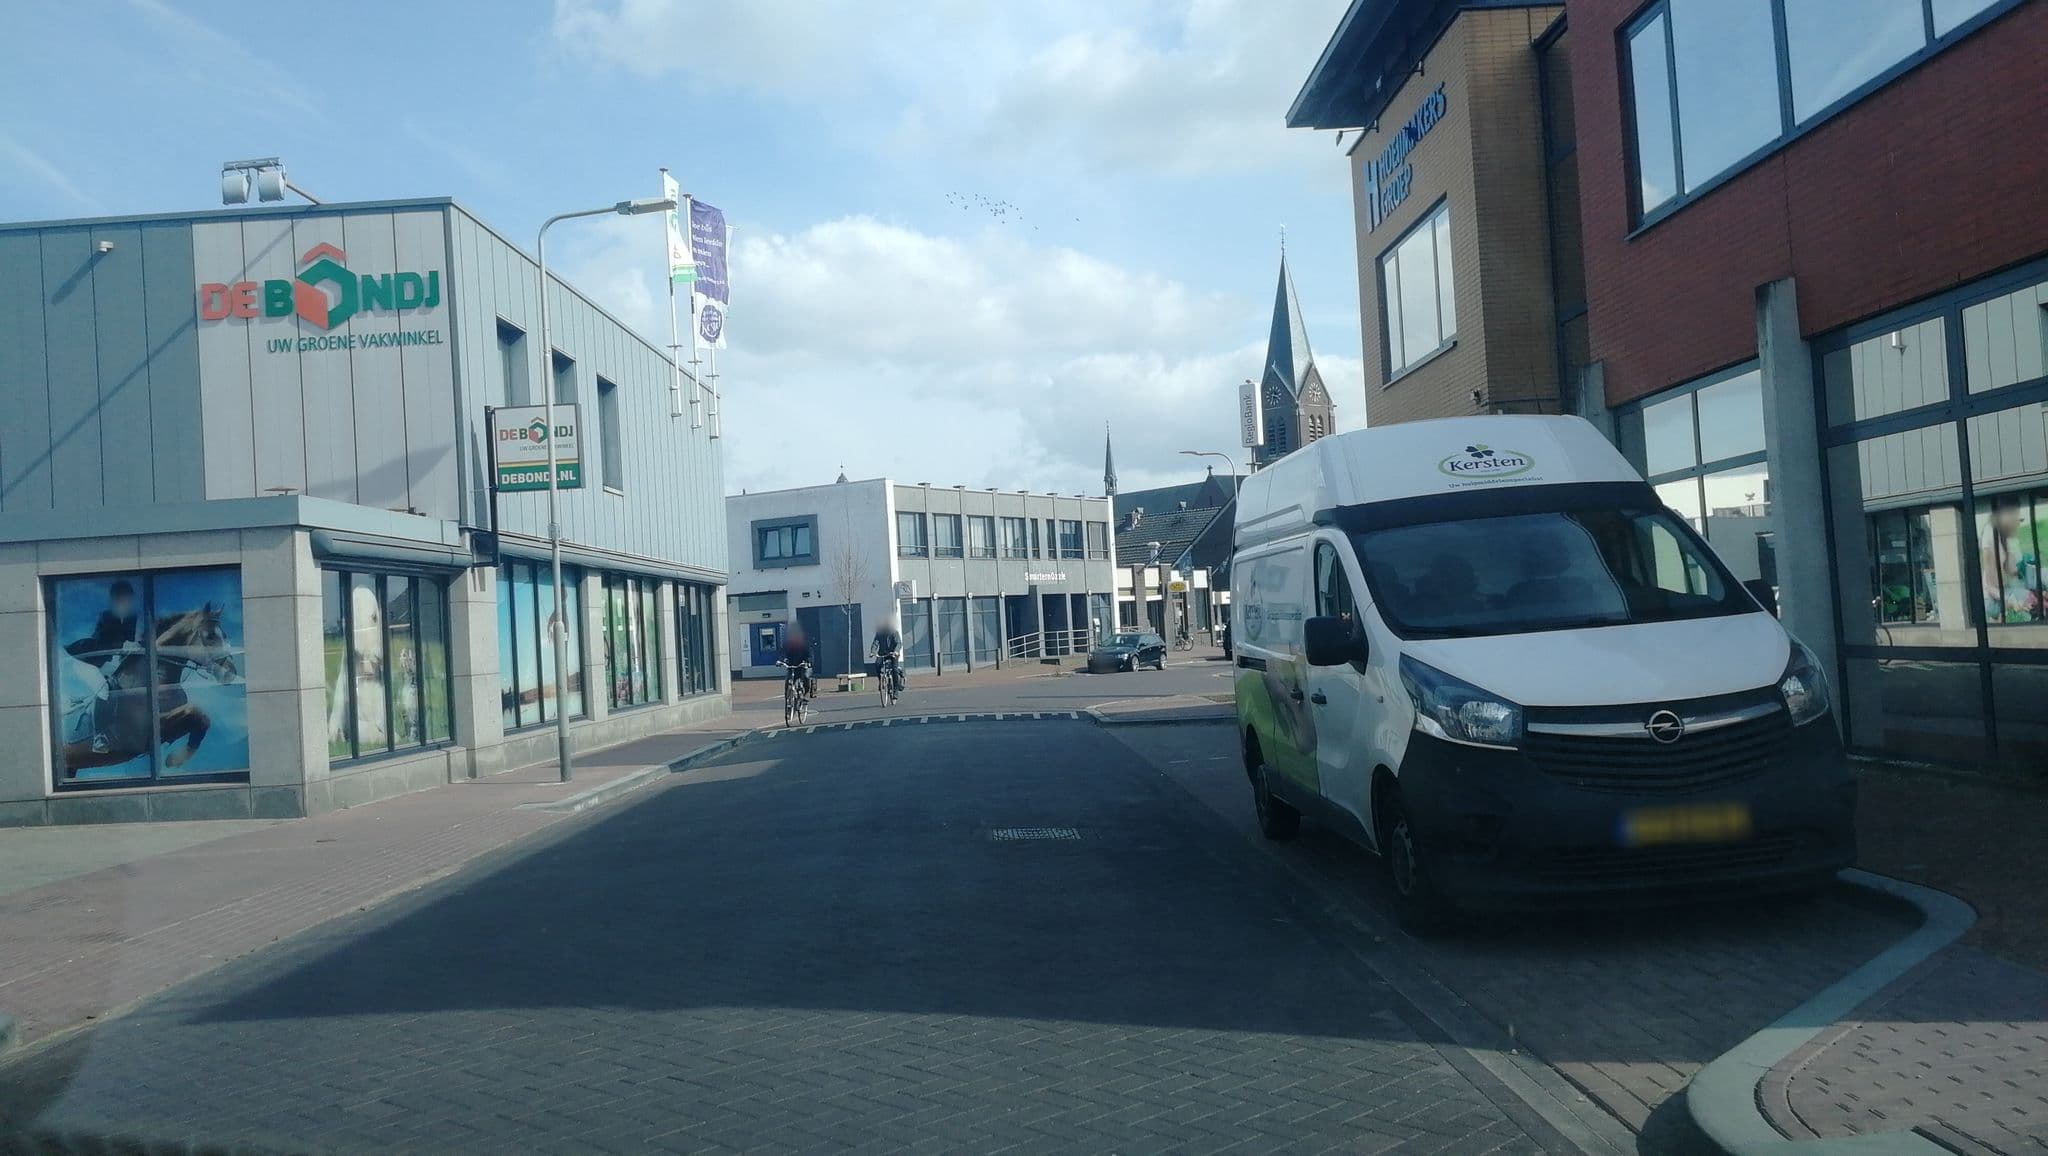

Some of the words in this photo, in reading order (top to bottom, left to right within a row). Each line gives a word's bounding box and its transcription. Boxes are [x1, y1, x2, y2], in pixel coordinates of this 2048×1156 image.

[1382, 163, 1413, 218] GROEP
[268, 337, 293, 354] UW
[297, 334, 356, 352] GROENE
[360, 329, 444, 349] VAKWINKEL
[1244, 393, 1256, 444] RegioBank
[1449, 457, 1525, 472] Kersten
[501, 470, 577, 485] DEBOND.NL
